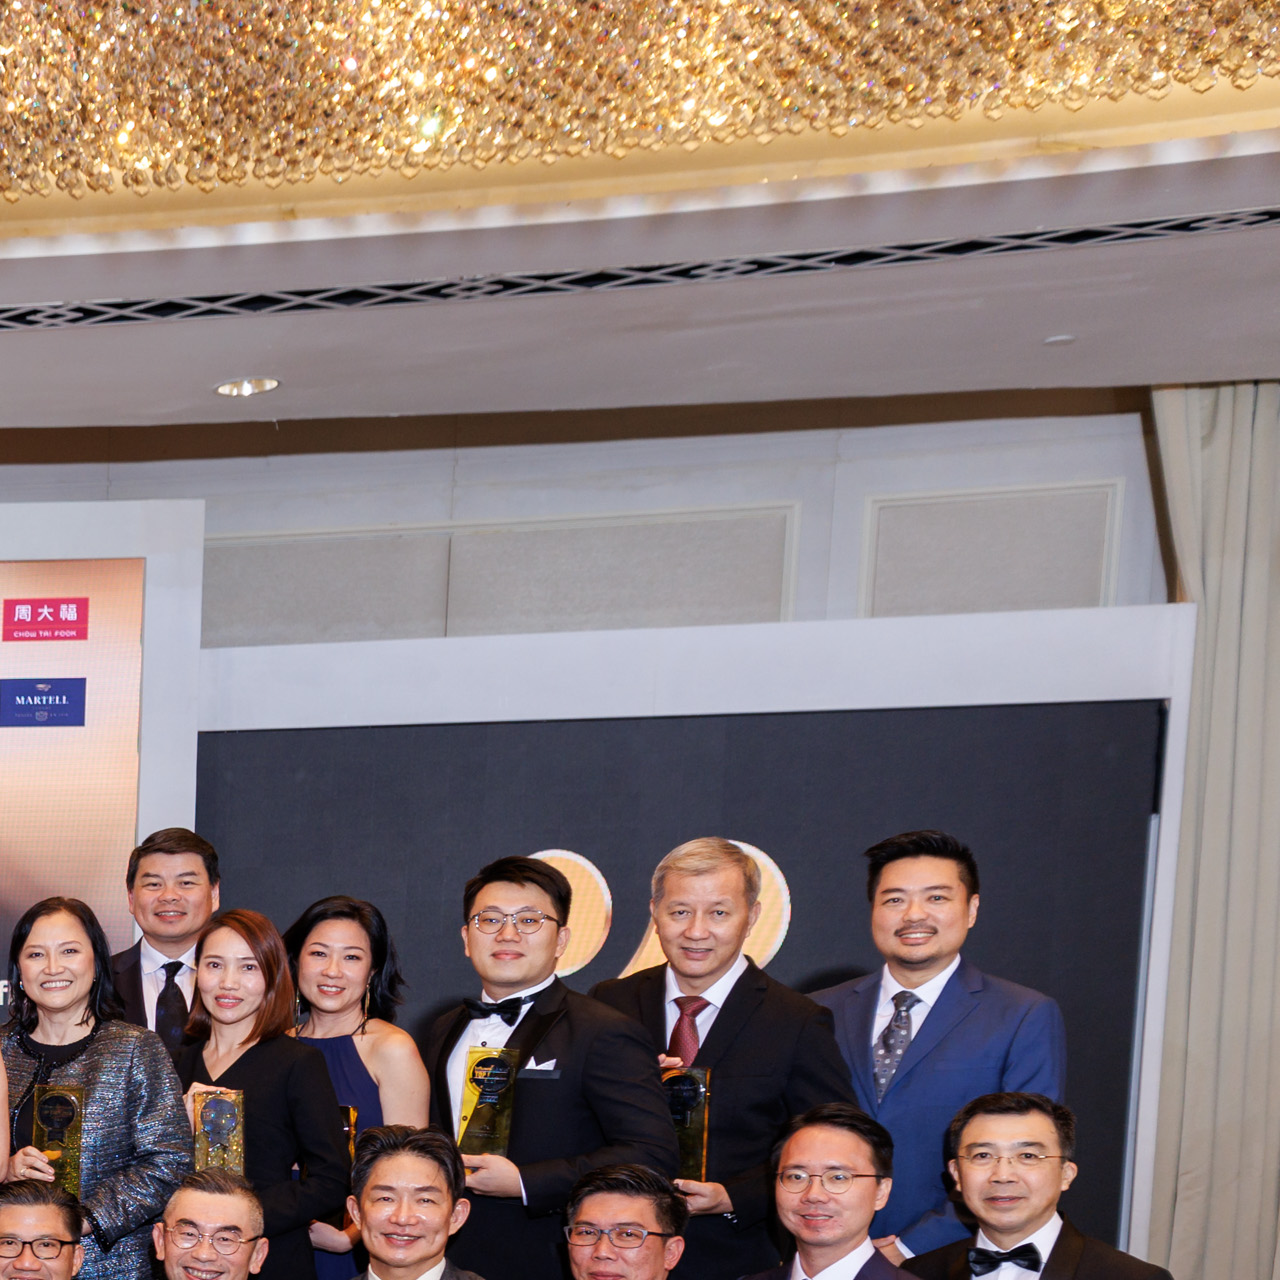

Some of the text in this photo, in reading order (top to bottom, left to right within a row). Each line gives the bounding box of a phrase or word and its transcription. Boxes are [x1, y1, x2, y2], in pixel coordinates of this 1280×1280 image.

[13, 603, 78, 623] 周大福
[13, 629, 77, 638] CHOW TAI FOOK
[15, 695, 70, 705] MARTELL
